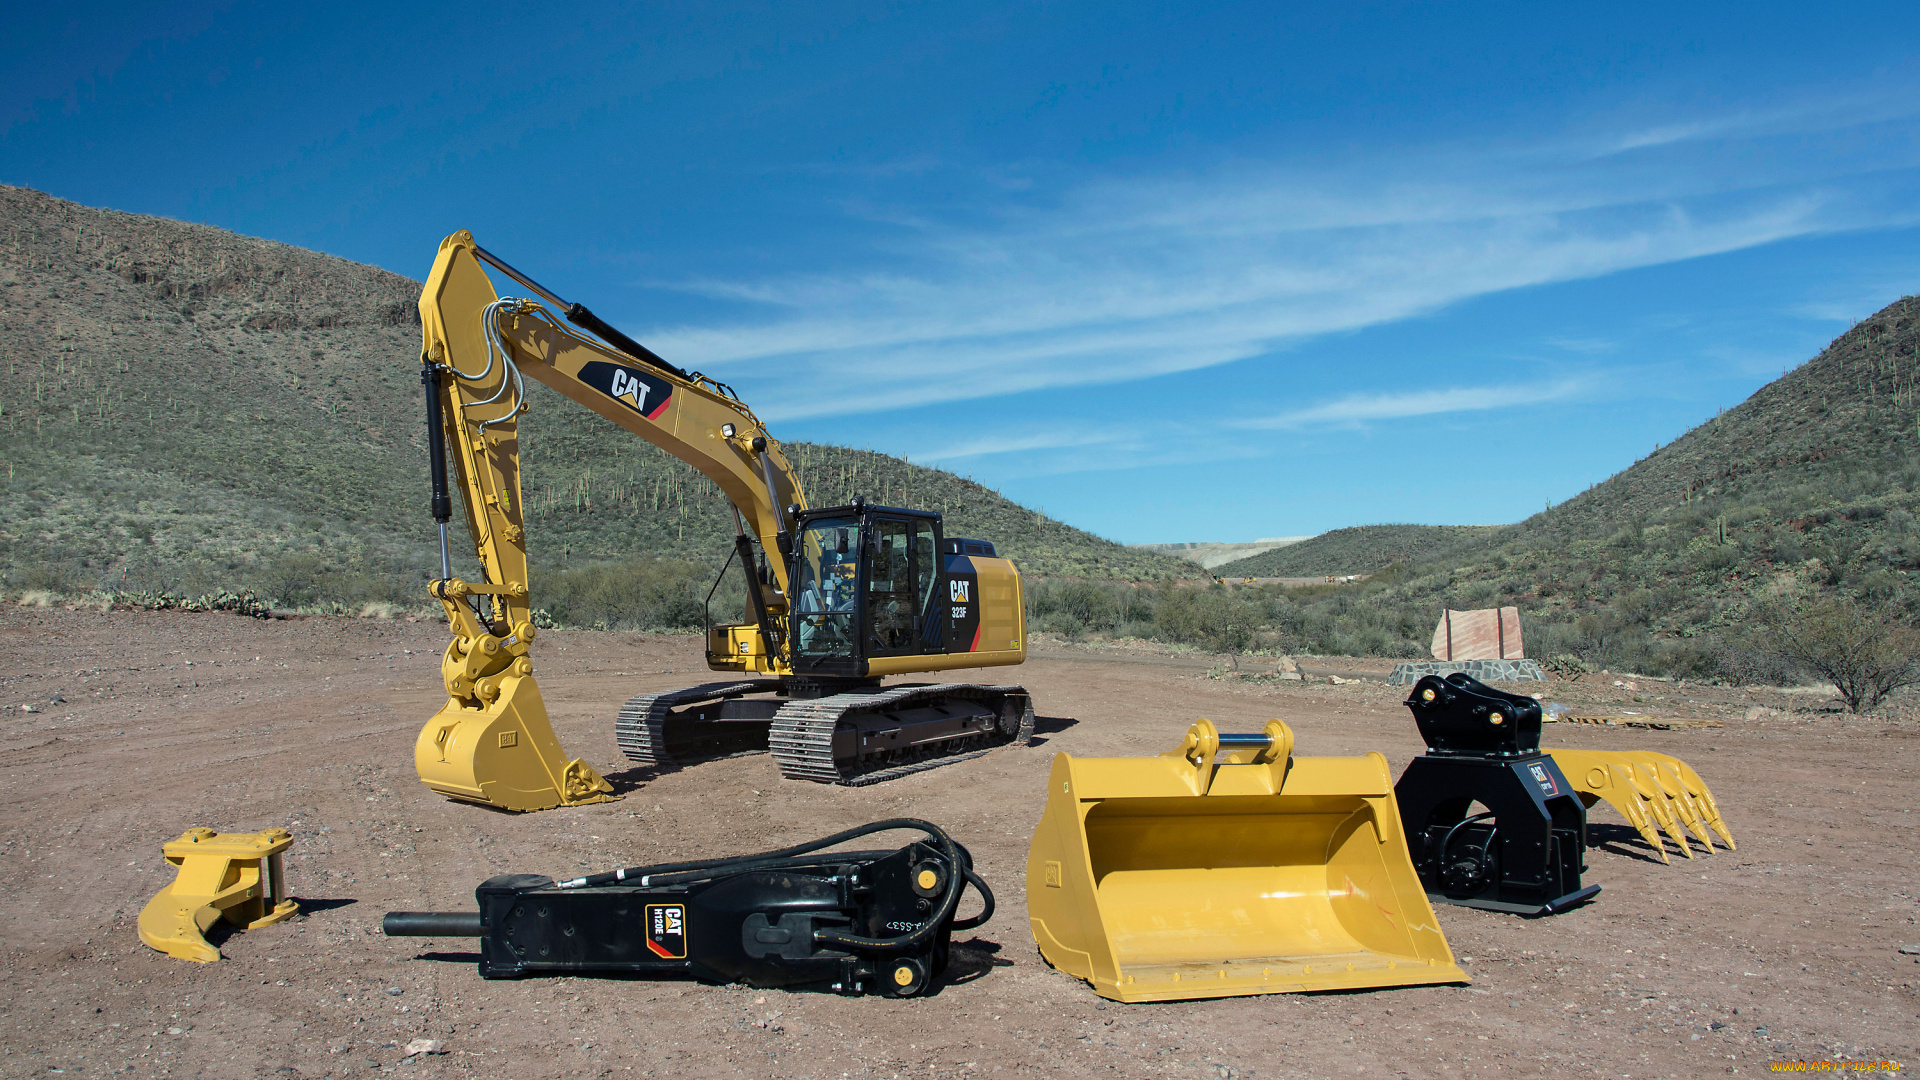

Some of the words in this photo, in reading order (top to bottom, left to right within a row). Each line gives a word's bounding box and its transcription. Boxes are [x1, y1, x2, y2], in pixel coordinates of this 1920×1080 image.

[611, 368, 651, 411] CAT
[950, 580, 969, 602] CAT
[951, 606, 967, 618] 323F
[1530, 765, 1548, 782] CAT
[654, 908, 664, 935] H120E
[665, 908, 682, 936] CAT
